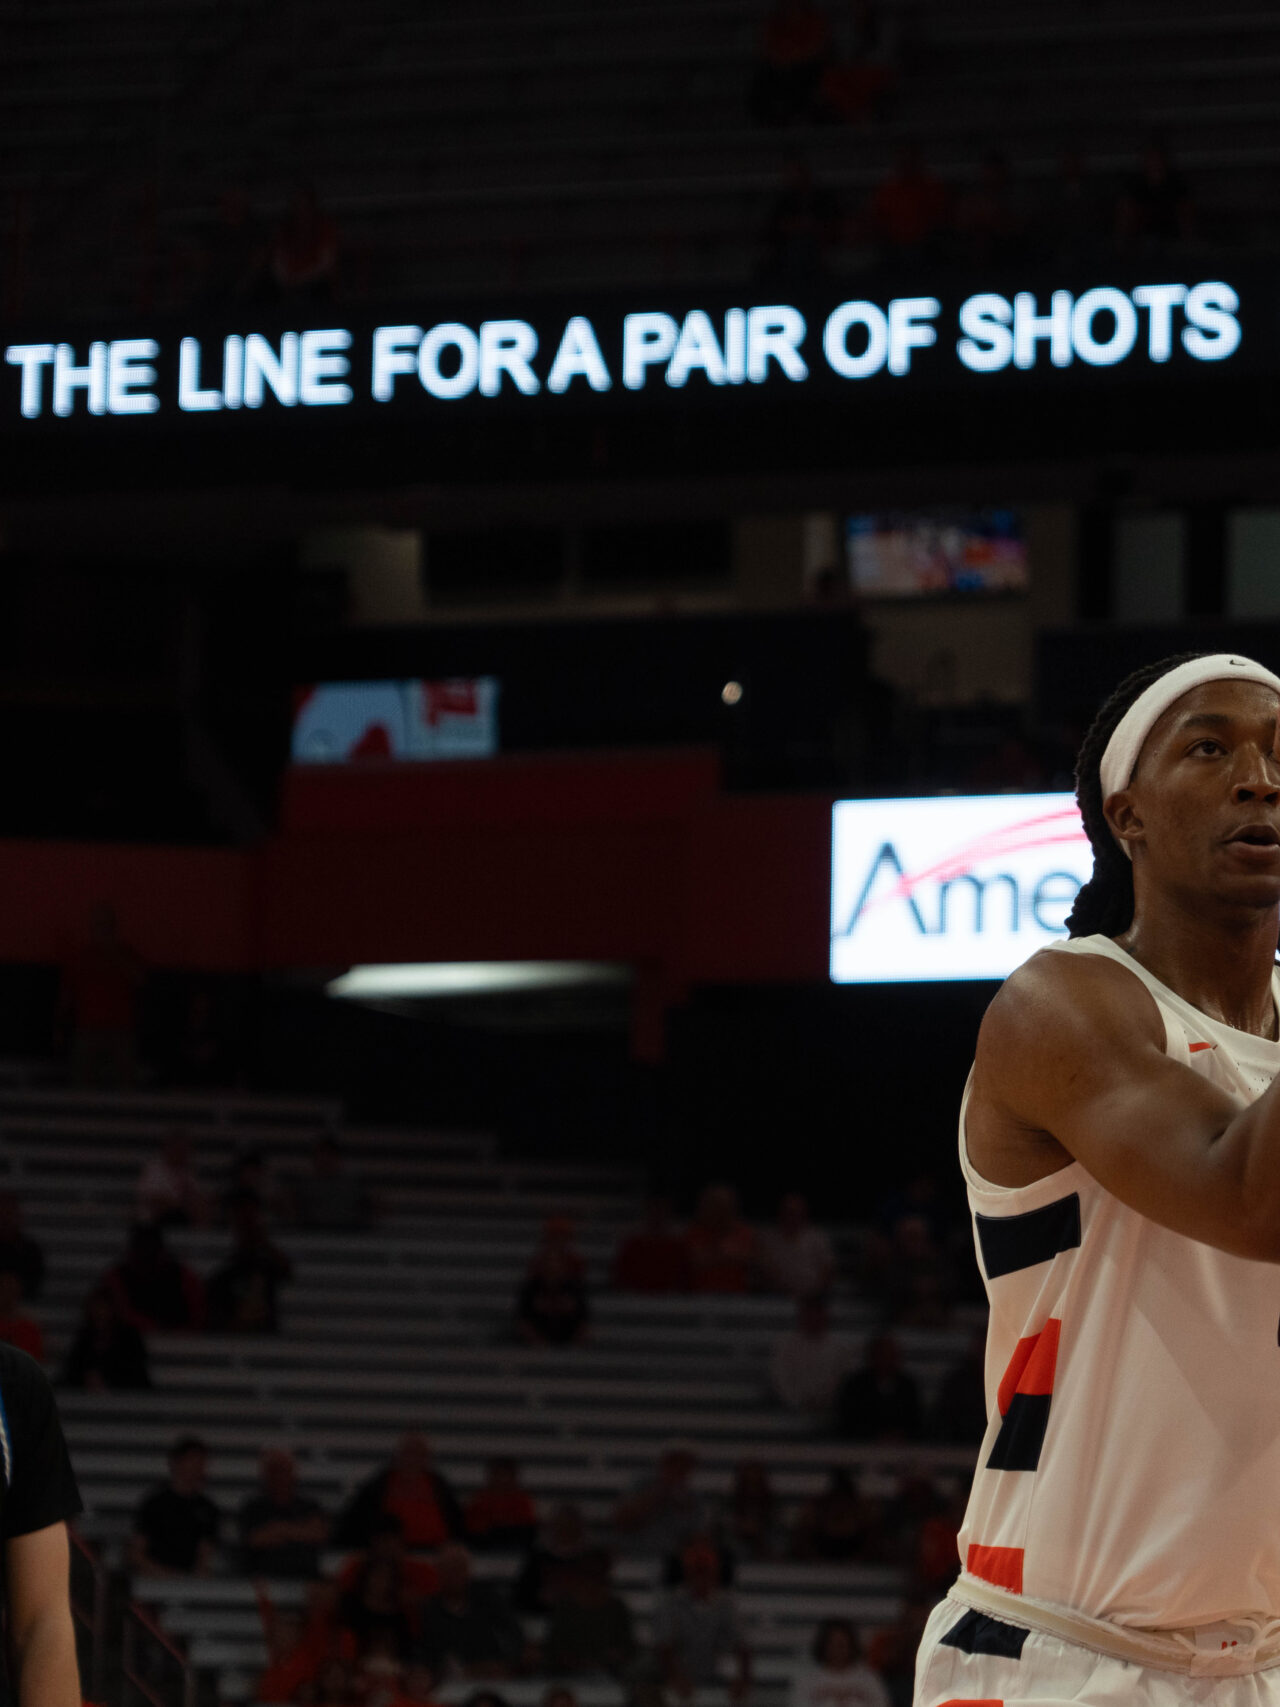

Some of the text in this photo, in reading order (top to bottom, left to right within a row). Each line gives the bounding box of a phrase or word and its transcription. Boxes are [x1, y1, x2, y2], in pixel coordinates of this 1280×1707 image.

[5, 339, 160, 419] THE
[178, 329, 353, 412] LINE
[371, 319, 541, 402] FOR
[547, 316, 611, 394] A
[622, 304, 809, 390] PAIR
[822, 296, 941, 379] OF
[956, 281, 1242, 373] SHOTS
